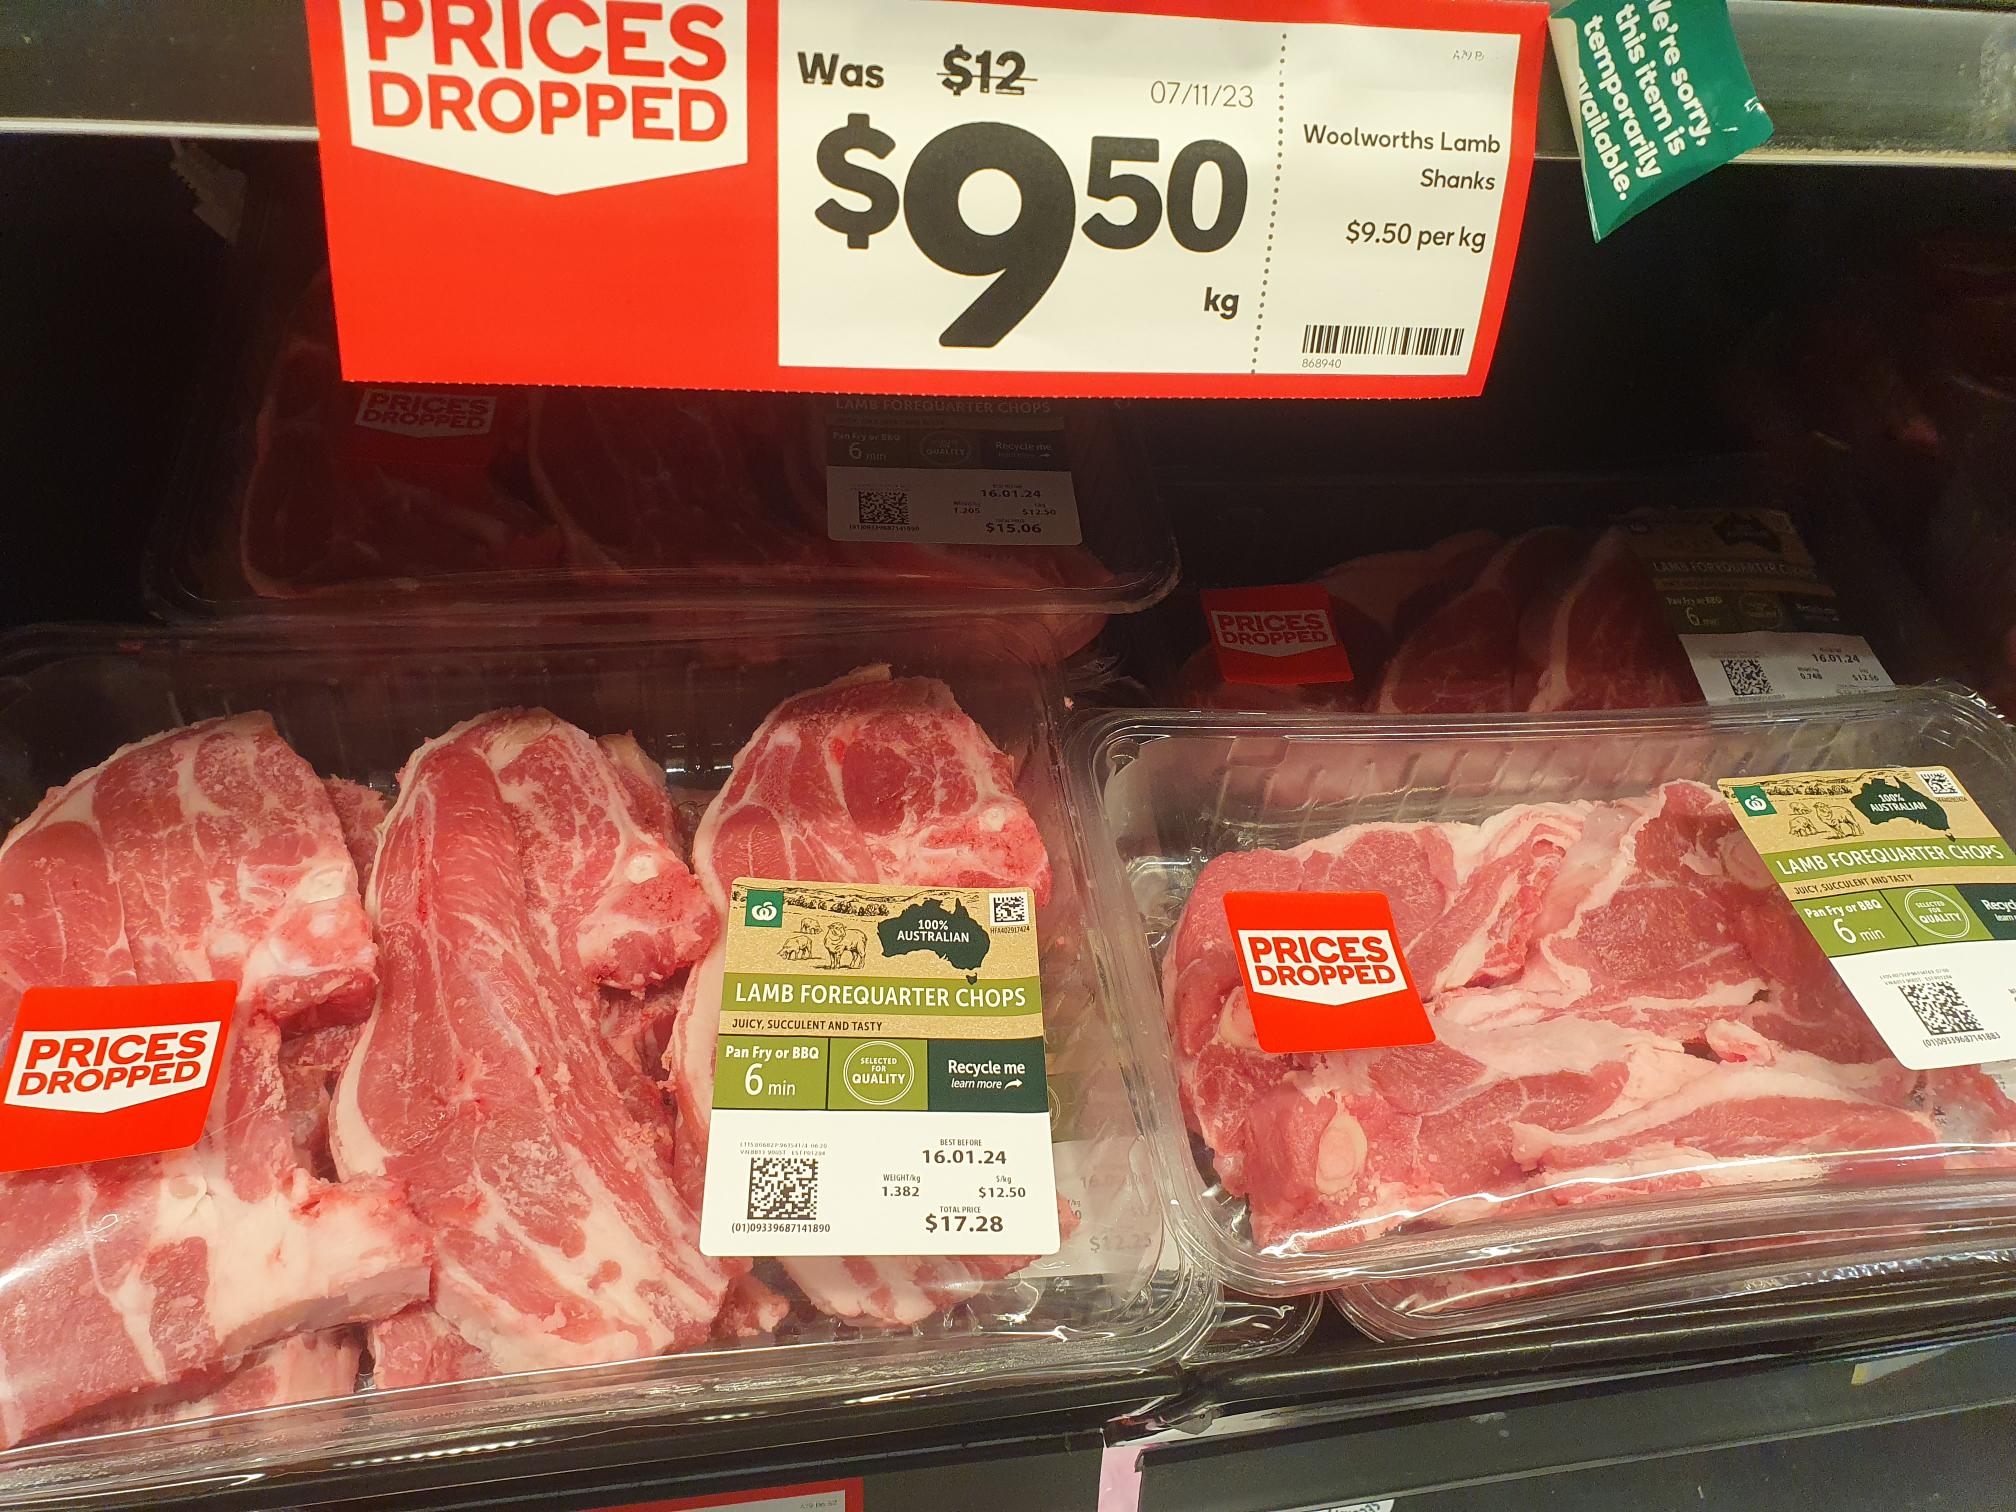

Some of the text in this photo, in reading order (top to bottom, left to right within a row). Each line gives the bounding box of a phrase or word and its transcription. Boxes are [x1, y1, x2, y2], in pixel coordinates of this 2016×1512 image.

[364, 0, 727, 82] PRICES
[798, 44, 1026, 96] Was $12
[1615, 3, 1686, 157] this item is
[1150, 80, 1254, 109] 07/11/23
[1584, 15, 1662, 179] temporarily
[368, 70, 728, 142] DROPPED
[1671, 67, 1711, 147] sorry,
[1303, 124, 1501, 154] Woolworths Lamb
[1420, 168, 1496, 191] Shanks
[1346, 219, 1486, 253] $9.50 per kg
[1203, 287, 1240, 320] kg
[1301, 357, 1342, 369] 868940
[366, 390, 490, 415] PRICES
[361, 408, 485, 429] DROPPED
[848, 442, 862, 460] 6
[980, 488, 1041, 499] 16.01.24
[985, 521, 1042, 534] $15.06
[1216, 613, 1325, 632] PRICES
[1220, 630, 1329, 645] DROPPED
[1812, 653, 1861, 664] 16.01.24
[1869, 801, 1928, 812] AUSTRALIAN
[1878, 793, 1905, 804] 100%
[1776, 845, 2004, 875] LAMB FOREQUARTER CHOPS
[1794, 874, 1914, 895] JUICY, SUCCULENT AND TASTY
[1804, 899, 1883, 919] Pan Fry or BBQ
[1919, 912, 1961, 924] QUALITY
[917, 919, 949, 932] 100%
[1833, 918, 1886, 944] 6 min
[897, 929, 970, 943] AUSTRALIAN
[1248, 936, 1389, 964] PRICES
[1255, 964, 1396, 986] DROPPED
[735, 982, 1027, 1008] LAMB FOREQUARTER CHOPS
[732, 1019, 883, 1031] JUICY, SUCCULENT AND TASTY
[25, 1029, 208, 1070] PRICES
[725, 1045, 820, 1062] Pan Fry or BBQ
[860, 1057, 897, 1065] SELECTED
[948, 1059, 1025, 1077] Recycle me
[17, 1061, 201, 1096] DROPPED
[744, 1062, 796, 1096] 6 min
[852, 1074, 905, 1085] QUALITY
[951, 1078, 1002, 1089] learn more
[957, 1139, 982, 1147] BEFORE
[922, 1149, 1007, 1164] 16.01.24
[883, 1174, 1012, 1184] WEIGHT/kg $/kg
[881, 1186, 1026, 1199] 1.382 $12.50
[962, 1206, 981, 1214] PRICE
[731, 1223, 831, 1234] (01)09339687141890
[925, 1213, 1004, 1233] $17.28
